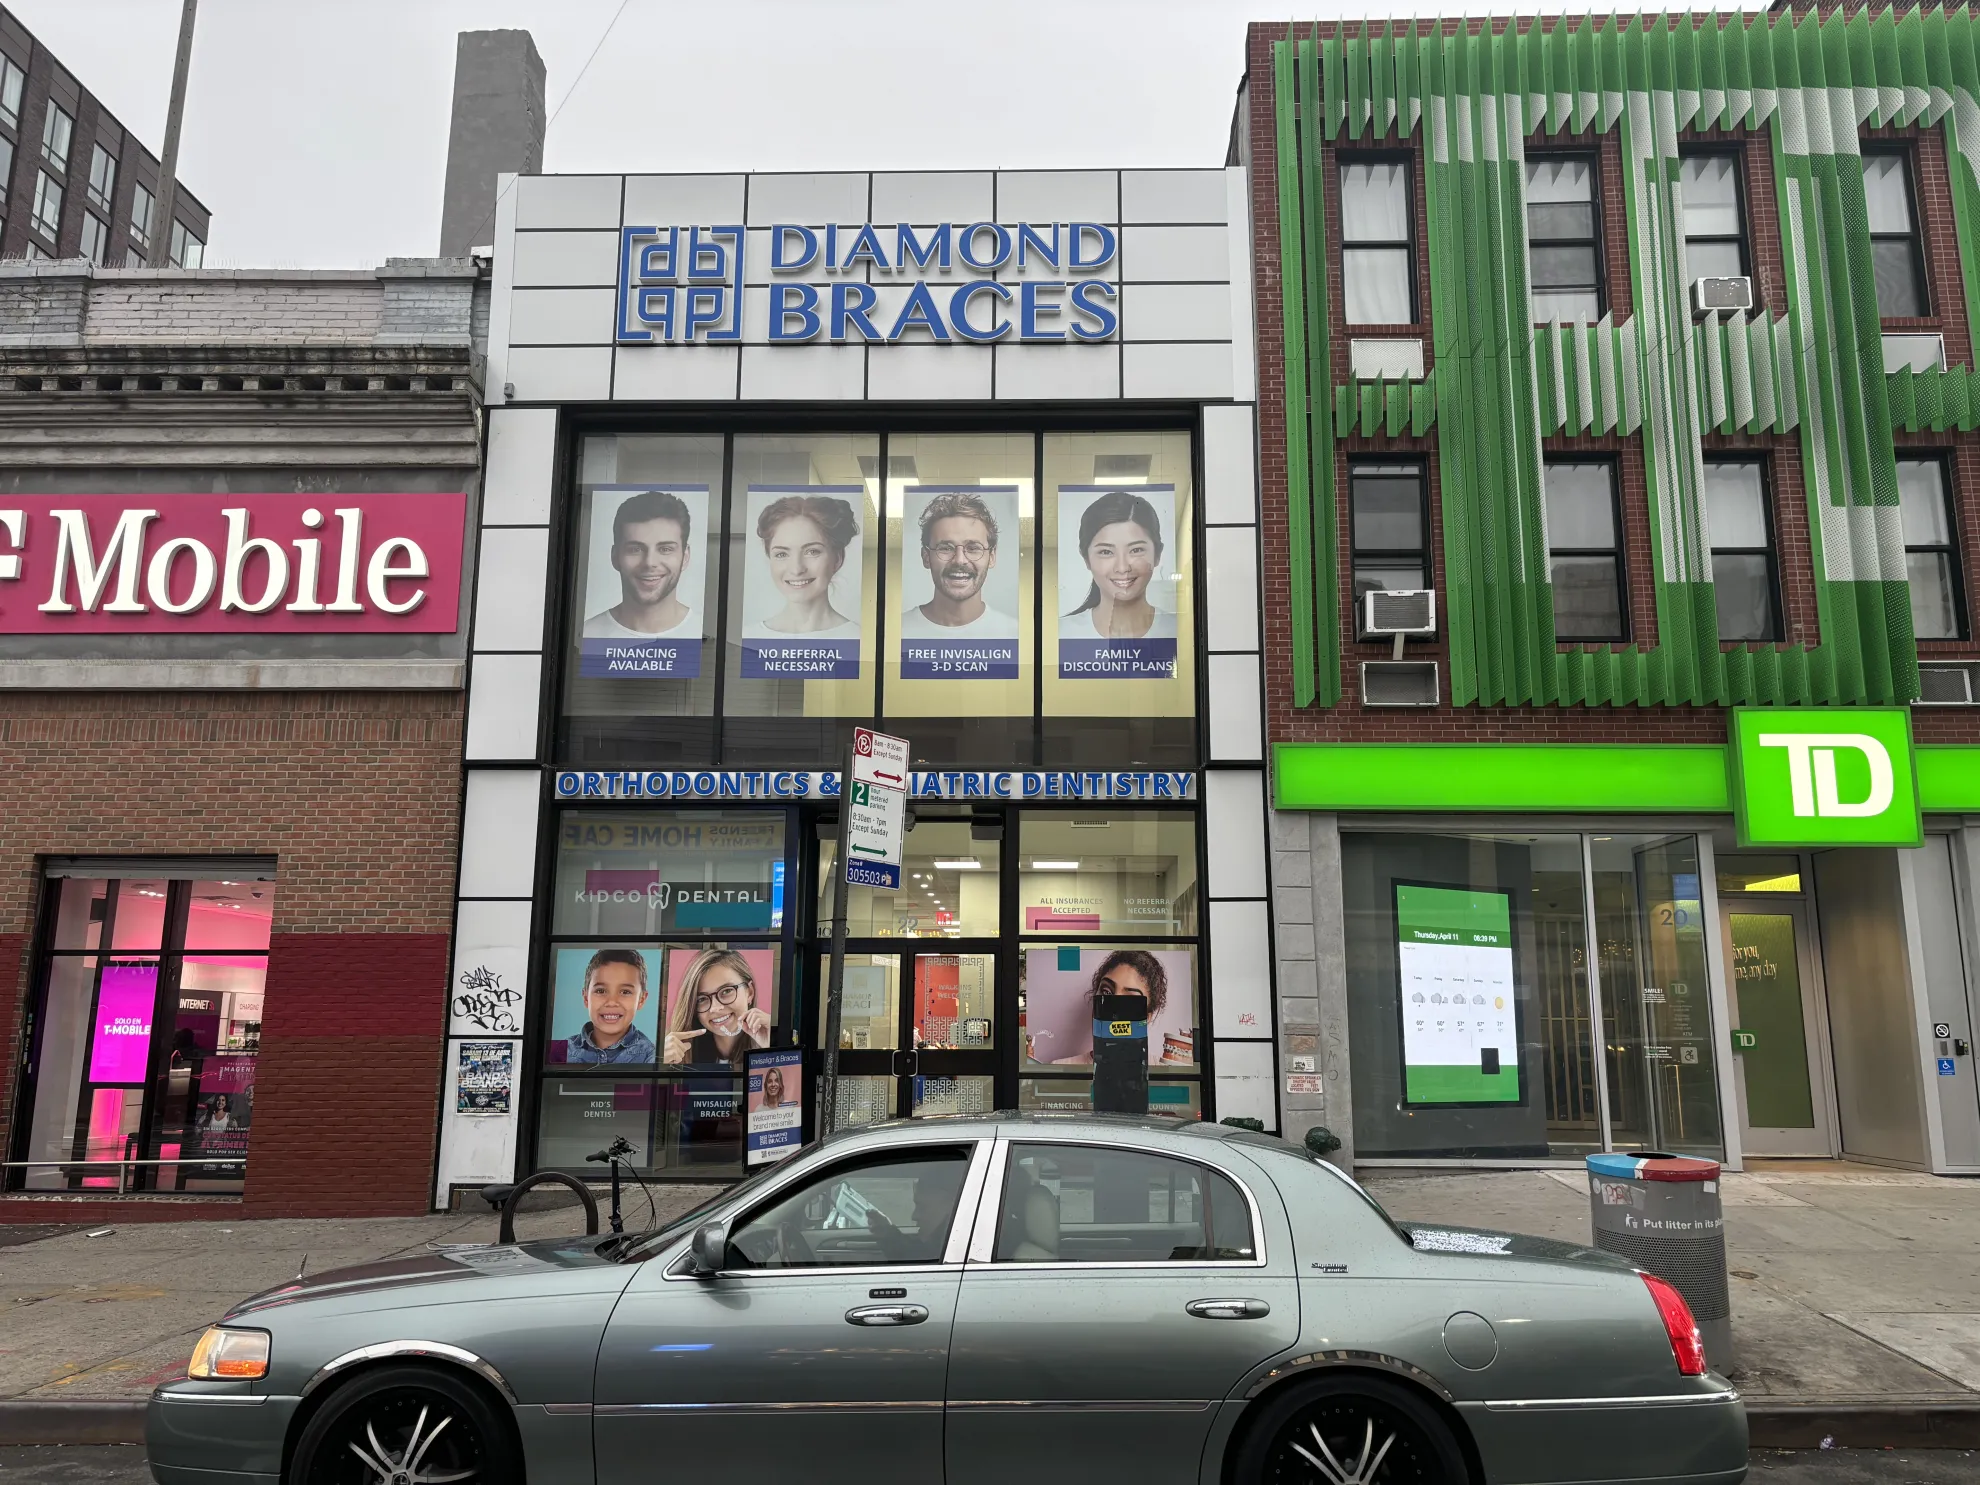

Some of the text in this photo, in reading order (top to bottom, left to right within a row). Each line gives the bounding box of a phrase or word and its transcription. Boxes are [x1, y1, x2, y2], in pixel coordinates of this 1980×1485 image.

[770, 221, 1117, 273] DIAMOND
[767, 278, 1118, 344] BRACES
[606, 648, 677, 659] FINANCING
[758, 648, 842, 660] NO REFERRAL
[908, 648, 1012, 660] FREE INVISALIGN
[1095, 648, 1141, 660] FAMILY
[608, 660, 673, 671] AVALABLE
[764, 661, 835, 672] NECESSARY
[931, 661, 988, 672] 3-D SCAN
[1063, 660, 1174, 672] DISCOUNT PLANS
[1758, 733, 1894, 818] TD
[557, 772, 810, 796] ORTHODONTICS
[819, 772, 842, 795] &
[1022, 771, 1193, 798] DENTISTRY
[856, 782, 865, 803] 2
[852, 822, 869, 833] Except
[848, 868, 880, 884] 305503
[575, 890, 764, 903] KIDCO DENTAL
[1660, 908, 1688, 926] 20
[179, 998, 210, 1010] INTERNET
[114, 1017, 142, 1025] SOLO EN
[103, 1024, 151, 1035] T-MOBILE
[1735, 1033, 1756, 1047] TD
[693, 1100, 738, 1108] INVISALIGN
[700, 1110, 730, 1118] BRACES
[752, 1111, 777, 1122] Welcome
[1643, 1218, 1663, 1229] Put
[1665, 1219, 1692, 1230] litter
[1694, 1219, 1703, 1229] in
[1704, 1219, 1714, 1228] its
